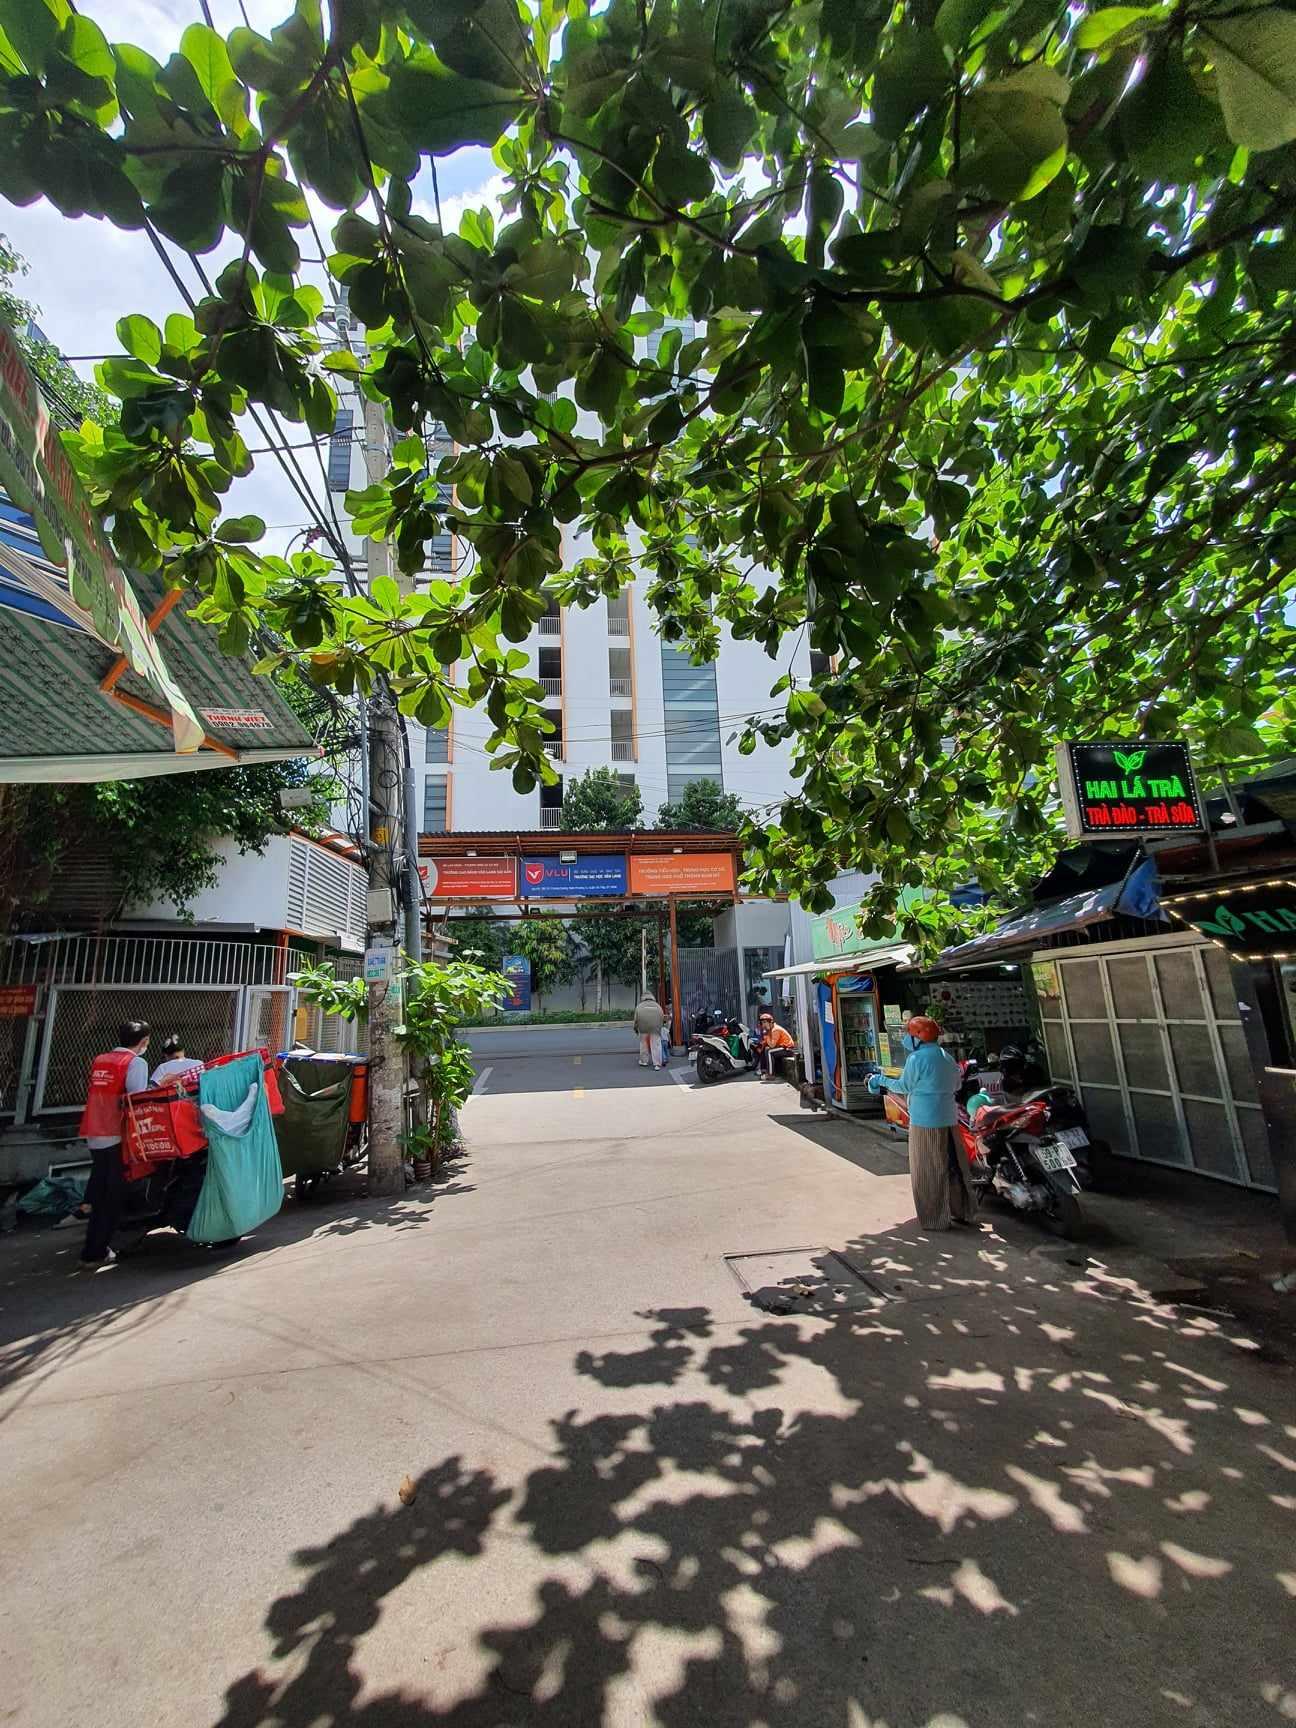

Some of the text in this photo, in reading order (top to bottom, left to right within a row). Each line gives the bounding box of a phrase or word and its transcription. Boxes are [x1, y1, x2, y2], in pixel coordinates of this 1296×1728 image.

[1085, 775, 1186, 799] HAI LÁ TRÀ
[545, 868, 568, 877] VLU
